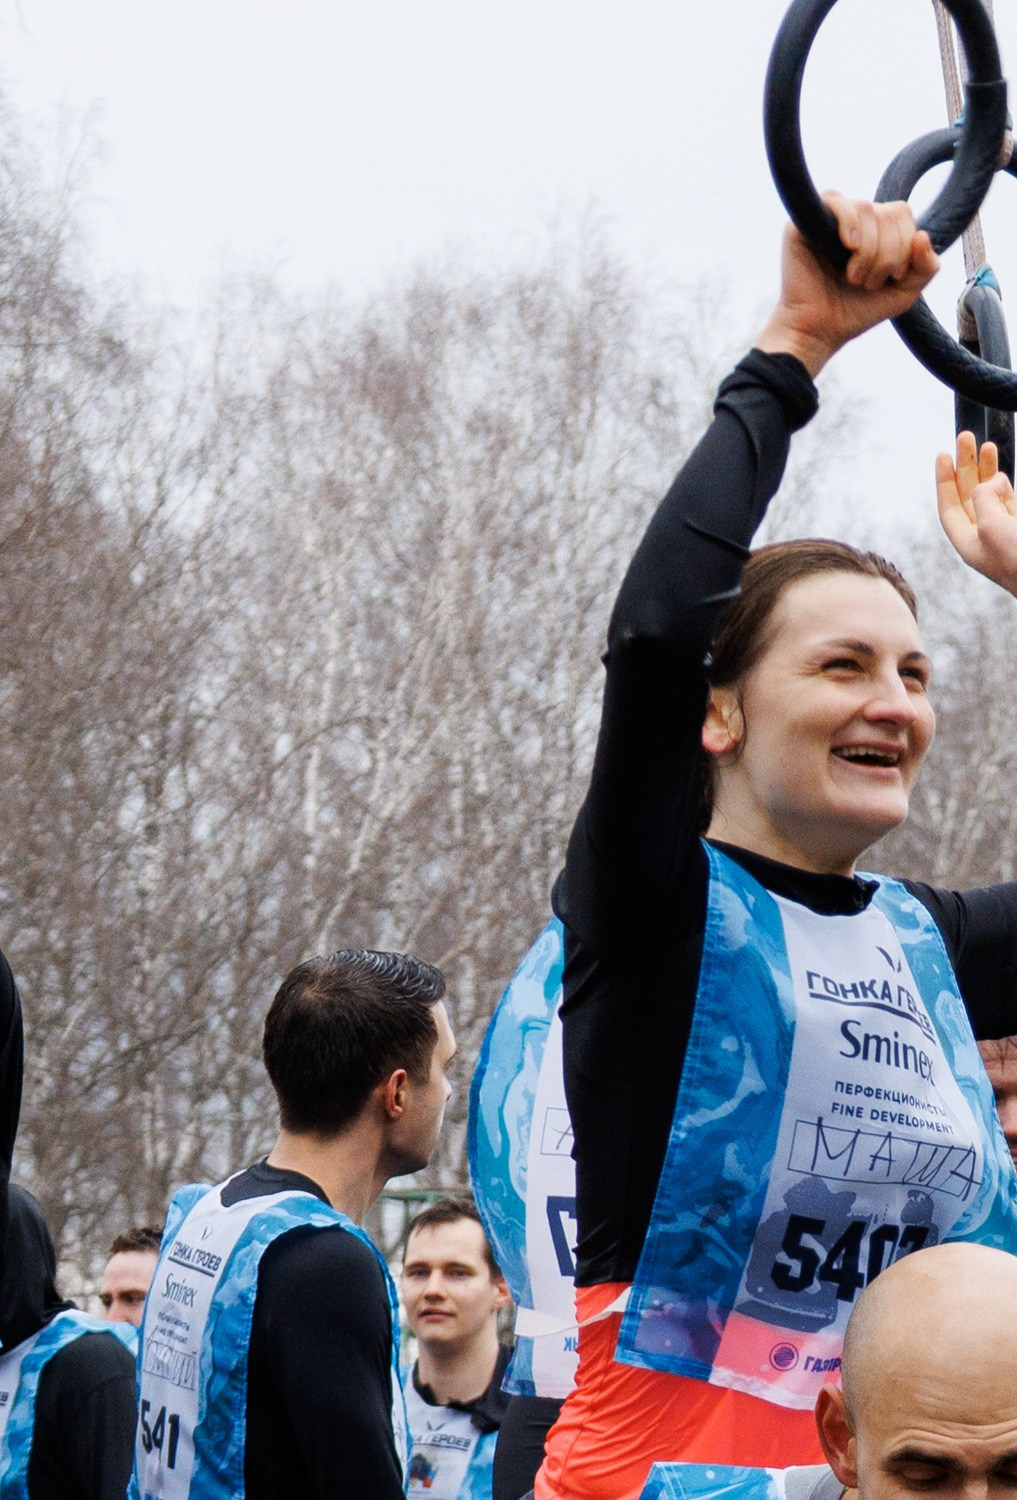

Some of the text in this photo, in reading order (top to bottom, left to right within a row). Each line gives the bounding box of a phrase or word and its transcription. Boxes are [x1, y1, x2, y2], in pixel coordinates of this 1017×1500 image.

[806, 970, 893, 1003] ГОНКА
[839, 1019, 934, 1086] Sminex
[831, 1102, 956, 1136] FINE DEVELOPMENT
[810, 1116, 983, 1201] МАША
